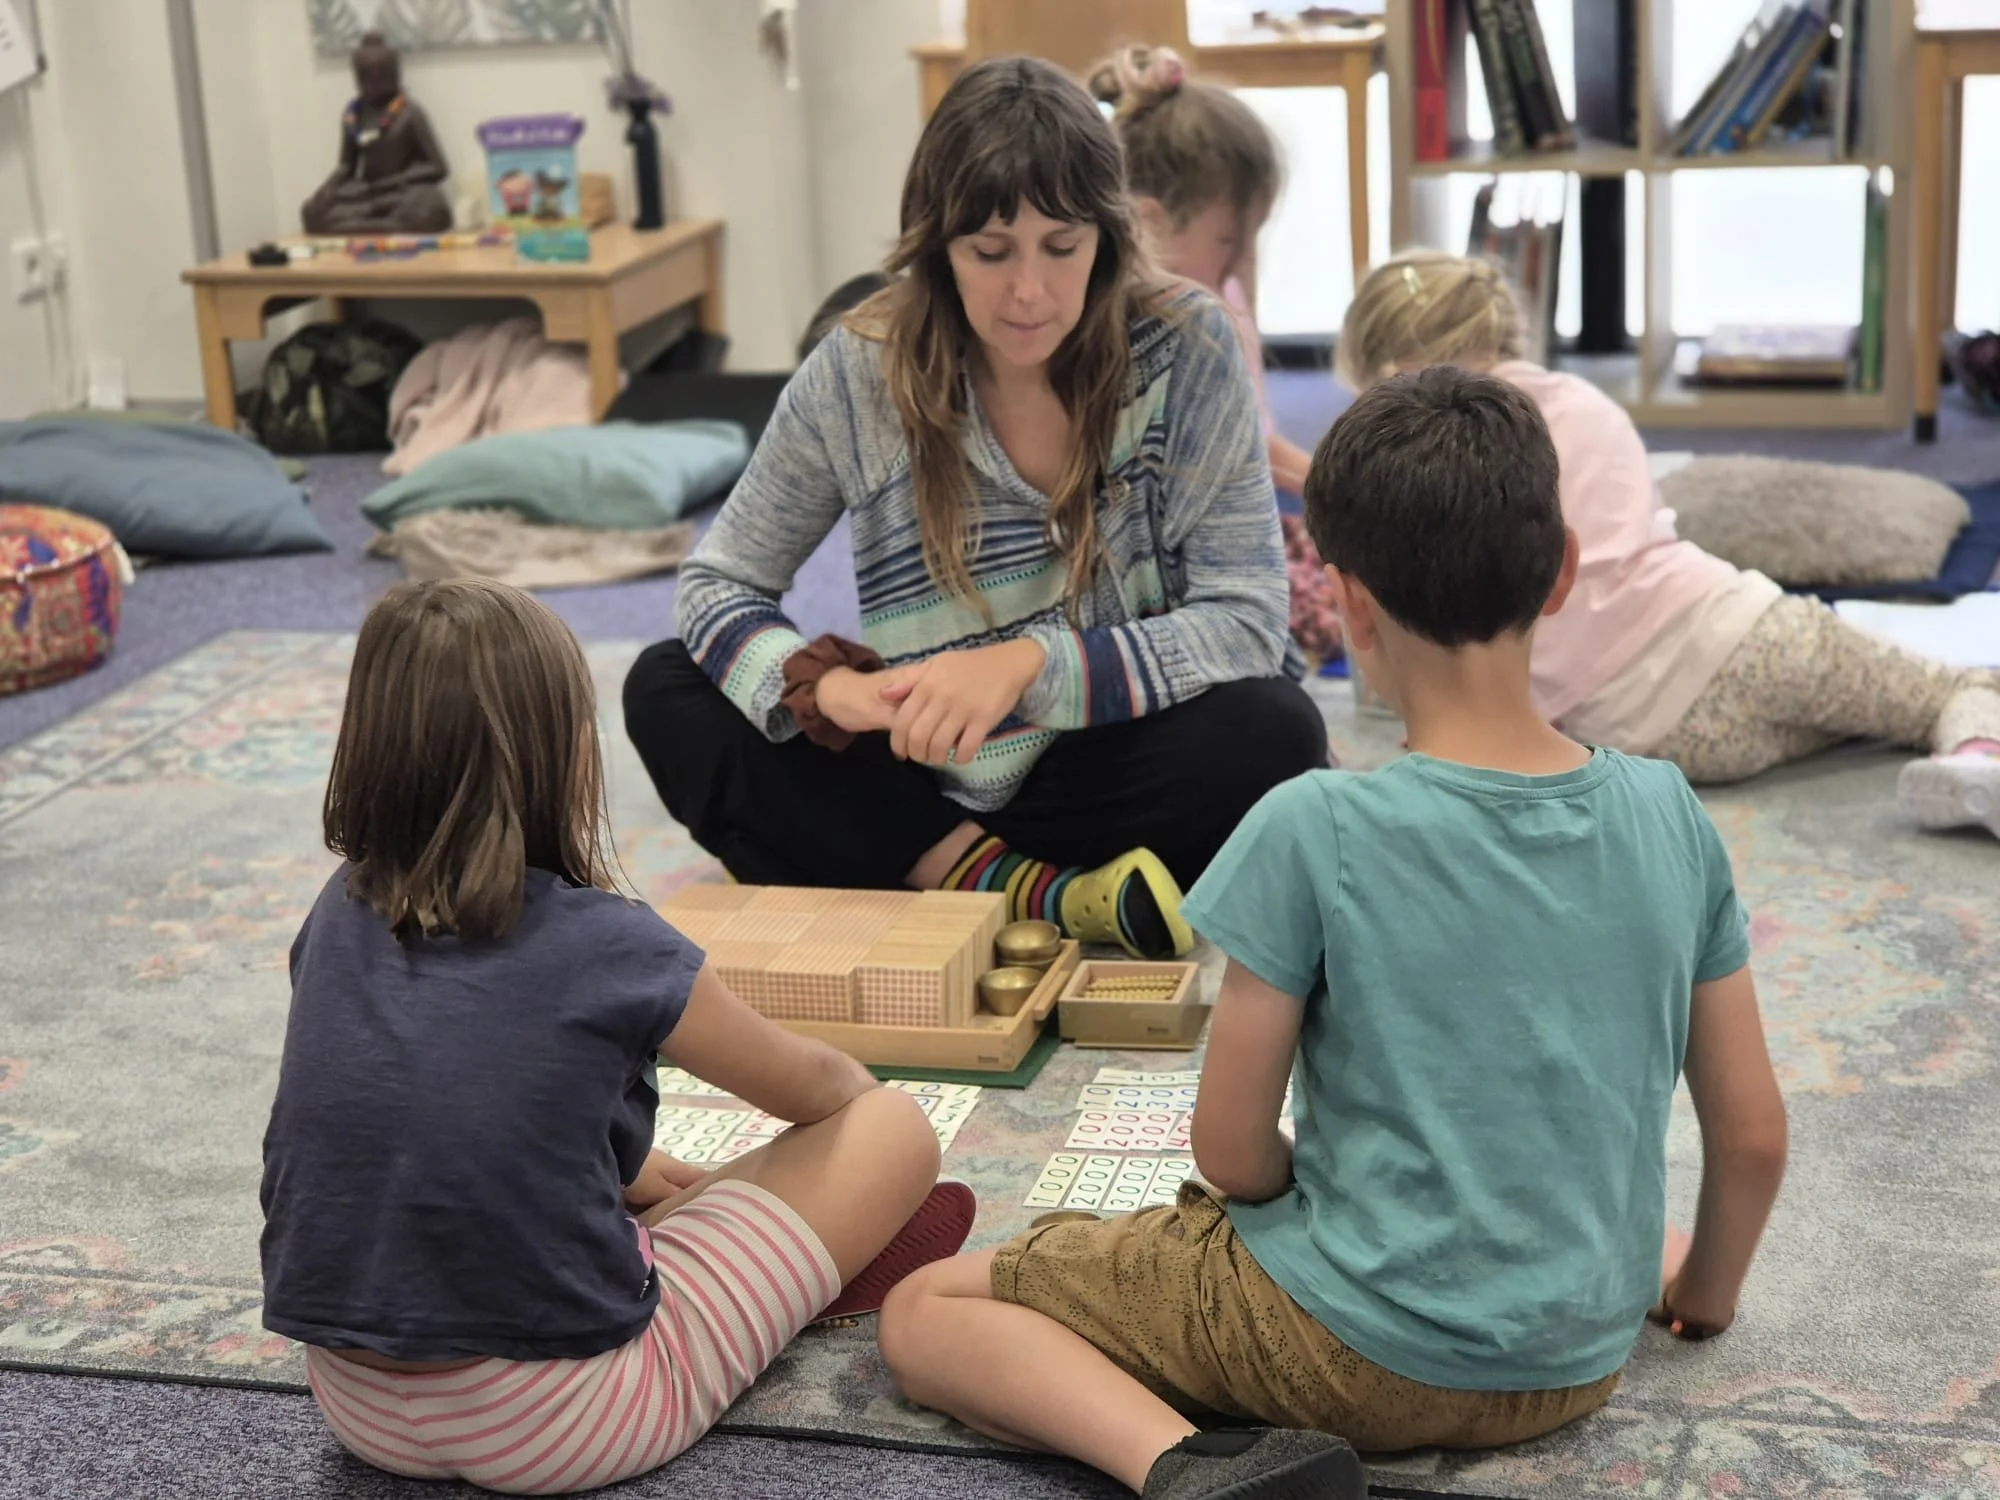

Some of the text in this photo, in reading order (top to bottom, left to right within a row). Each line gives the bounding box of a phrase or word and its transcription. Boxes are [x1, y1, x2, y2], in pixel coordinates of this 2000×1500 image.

[1114, 1088, 1142, 1108] 20
[1146, 1089, 1174, 1109] 30
[1071, 1112, 1108, 1145] 100
[1103, 1113, 1141, 1148] 200
[1135, 1113, 1172, 1148] 300
[1032, 1155, 1079, 1204] 1000
[1071, 1157, 1116, 1206] 2000
[1110, 1159, 1153, 1208] 3000
